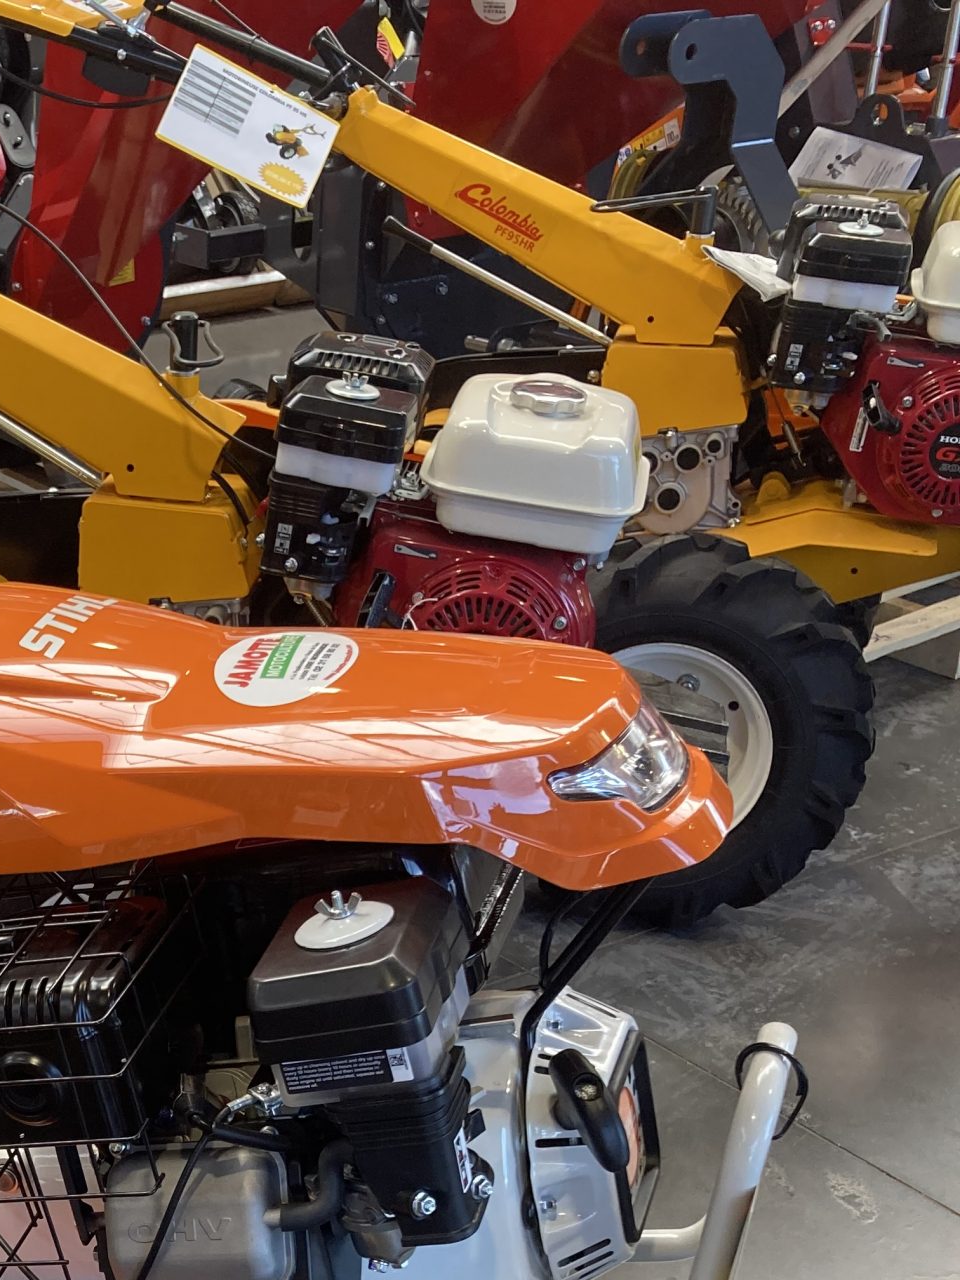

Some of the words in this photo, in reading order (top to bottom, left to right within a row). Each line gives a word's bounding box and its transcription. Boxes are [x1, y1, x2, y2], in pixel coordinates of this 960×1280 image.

[454, 183, 544, 242] Colombia
[494, 224, 535, 253] PF95HR
[935, 447, 960, 462] G
[19, 595, 120, 660] STIHL
[127, 1217, 233, 1244] OHV
